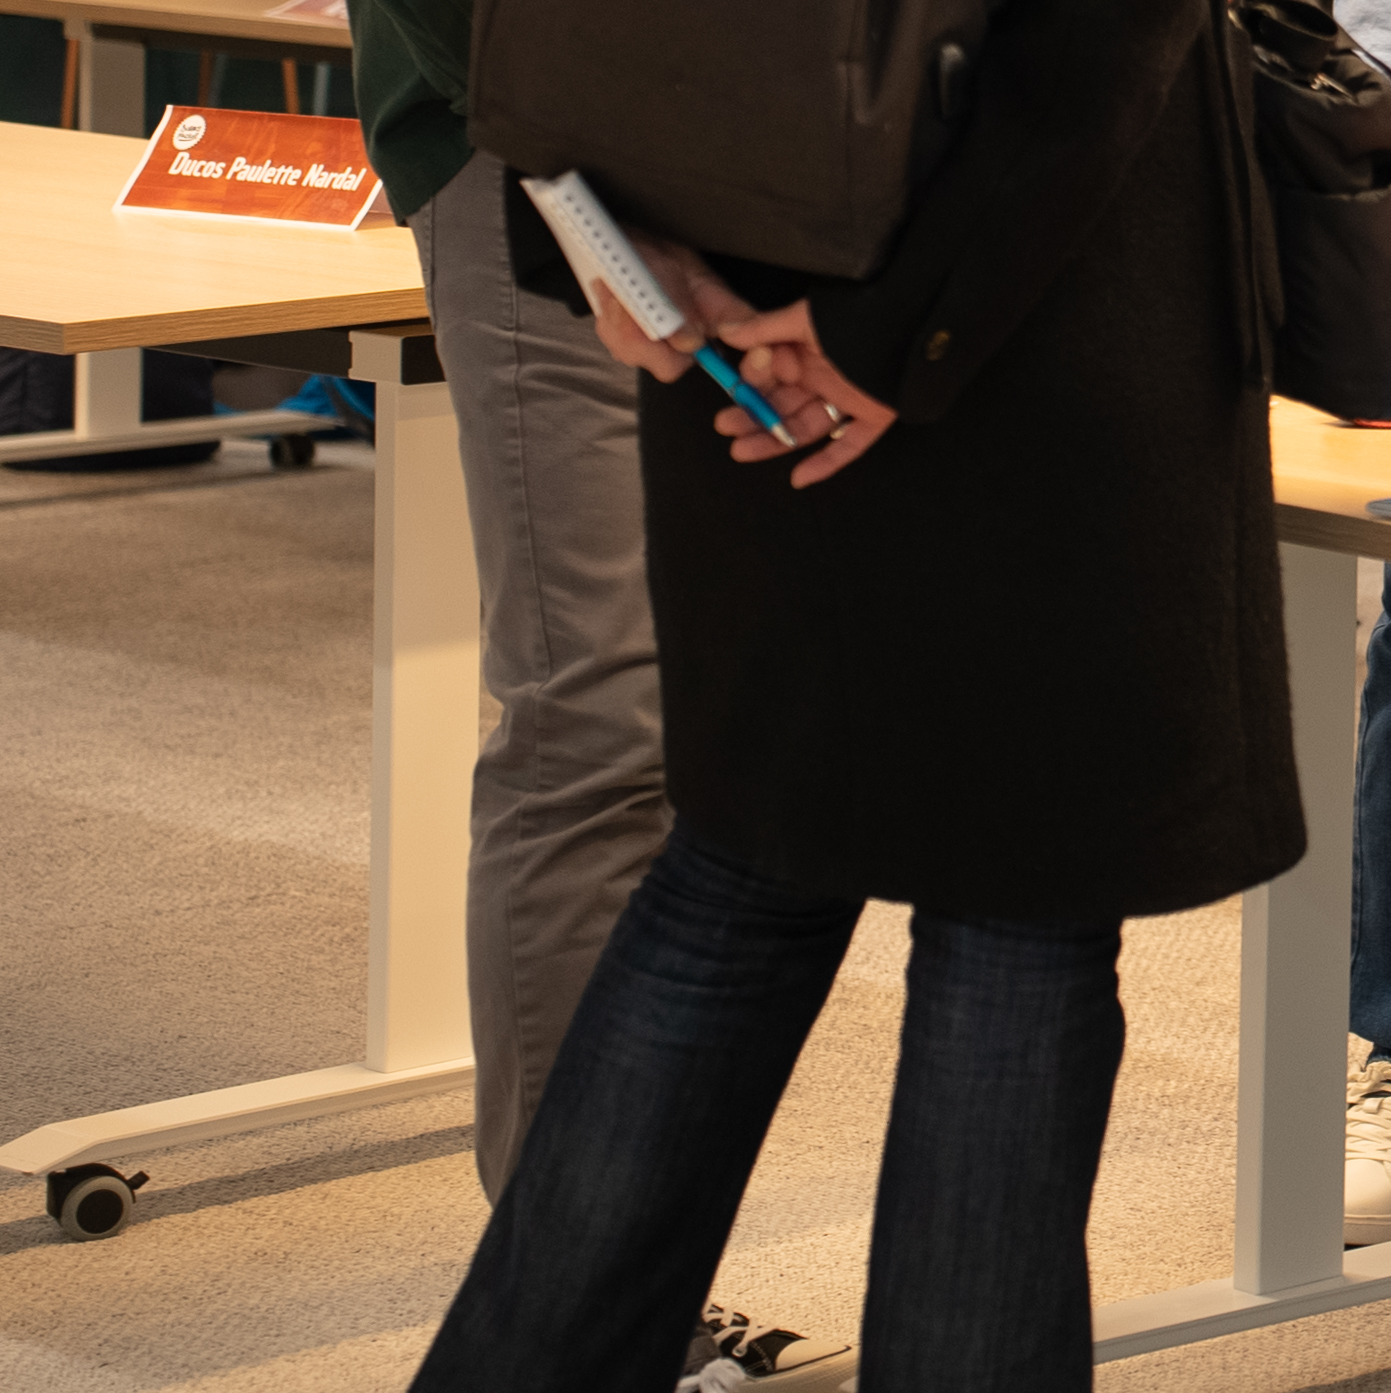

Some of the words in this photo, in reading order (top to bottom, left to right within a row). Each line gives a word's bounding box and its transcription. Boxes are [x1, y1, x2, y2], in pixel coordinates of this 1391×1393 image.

[168, 152, 225, 179] Ducos
[226, 157, 302, 186] Paulette
[302, 164, 367, 191] Nardal
